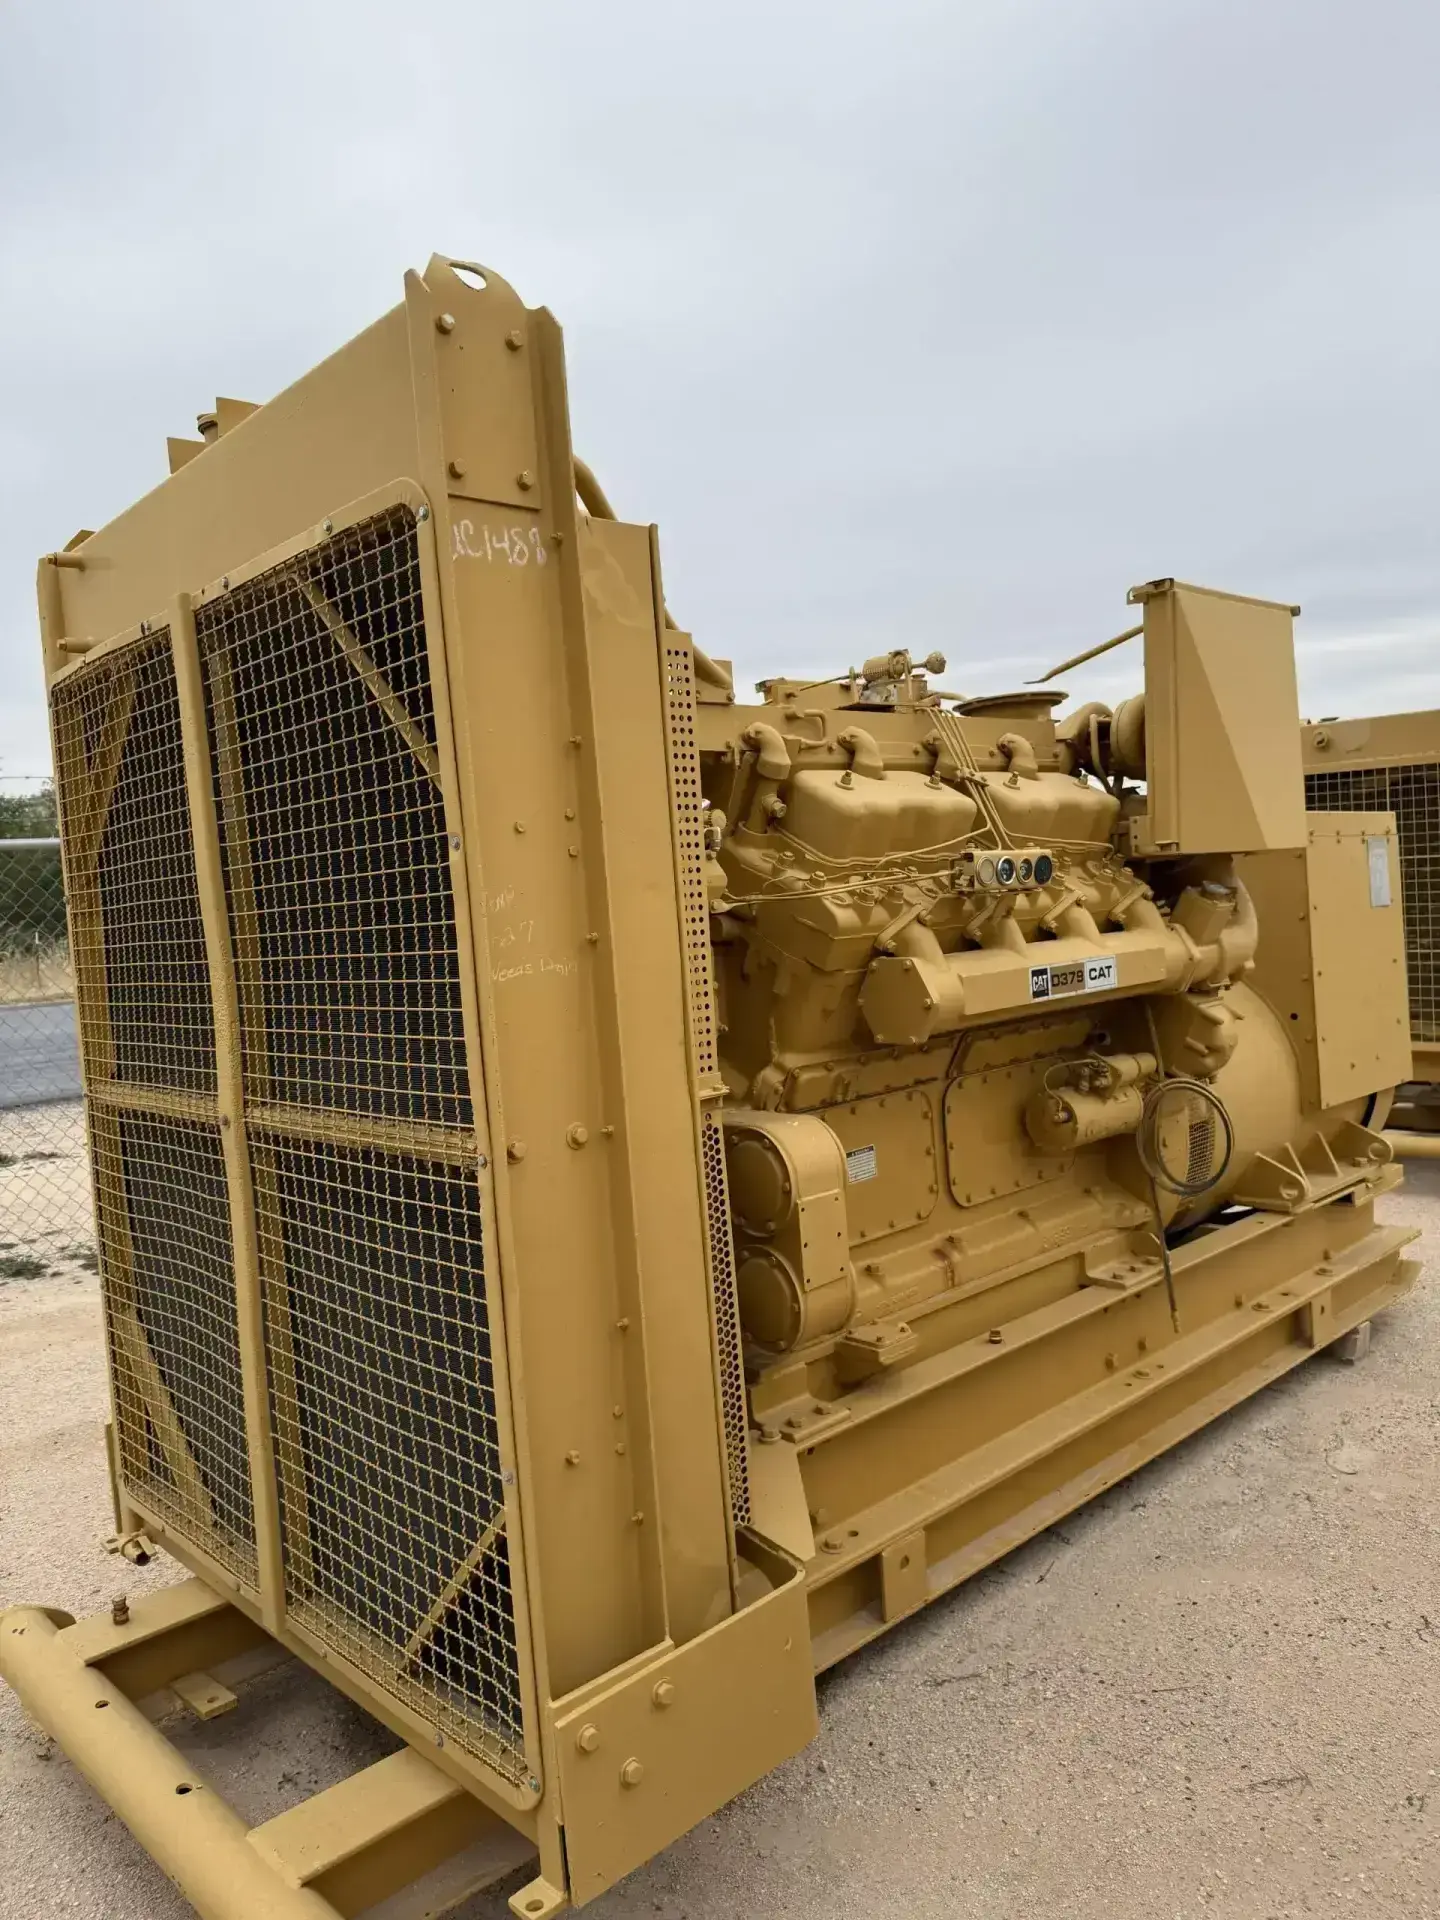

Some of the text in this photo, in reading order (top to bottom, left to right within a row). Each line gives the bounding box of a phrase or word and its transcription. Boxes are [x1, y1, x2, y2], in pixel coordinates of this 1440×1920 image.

[1032, 965, 1113, 992] CAT D379 CAT
